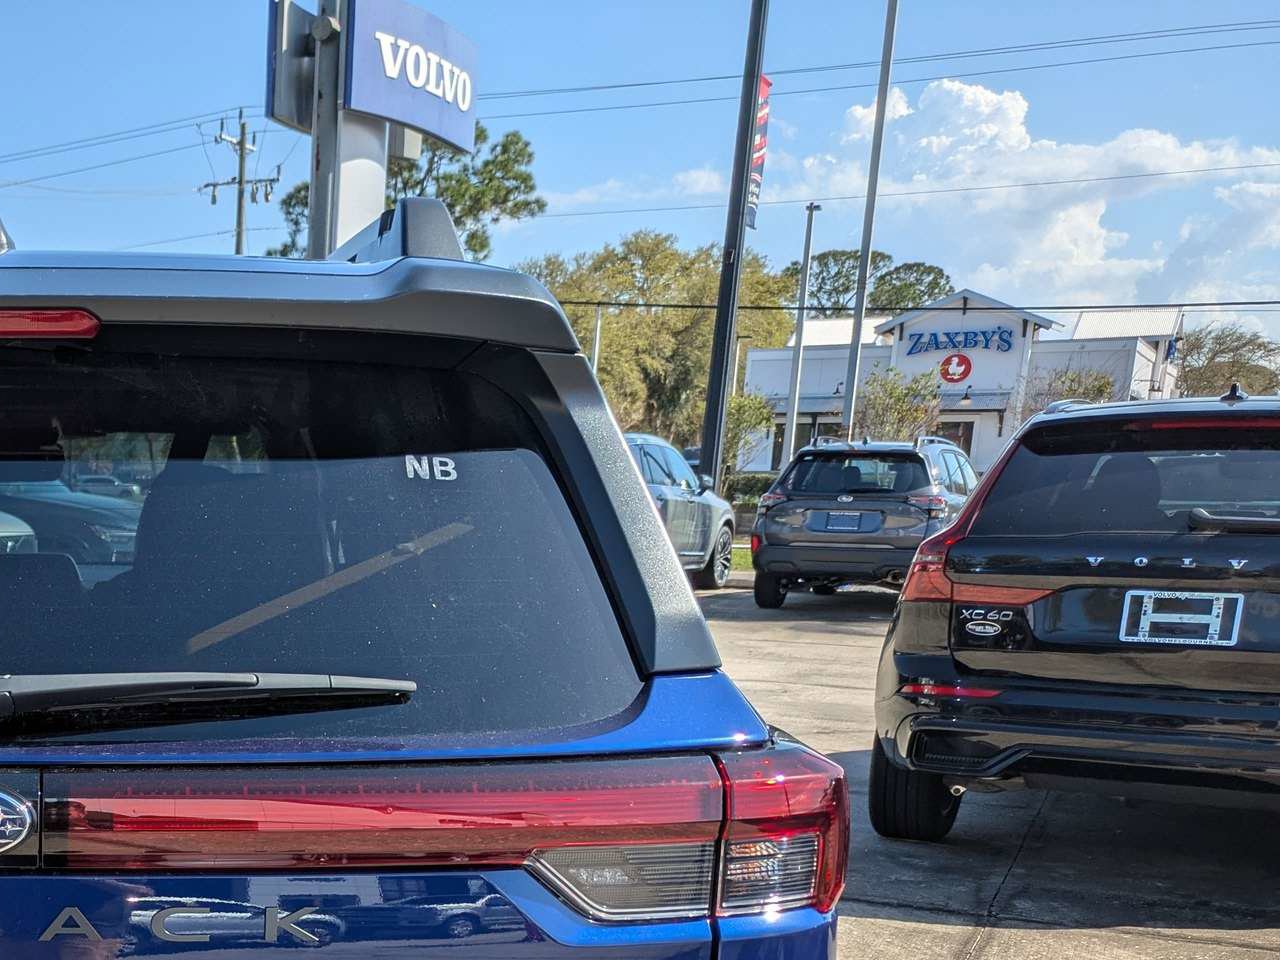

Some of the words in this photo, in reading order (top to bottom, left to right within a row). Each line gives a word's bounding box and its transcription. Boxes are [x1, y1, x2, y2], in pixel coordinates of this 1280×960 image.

[374, 31, 471, 112] VOLVO
[906, 326, 1013, 356] ZAXBY'S
[405, 454, 458, 480] NB
[1152, 591, 1177, 599] VOLVO
